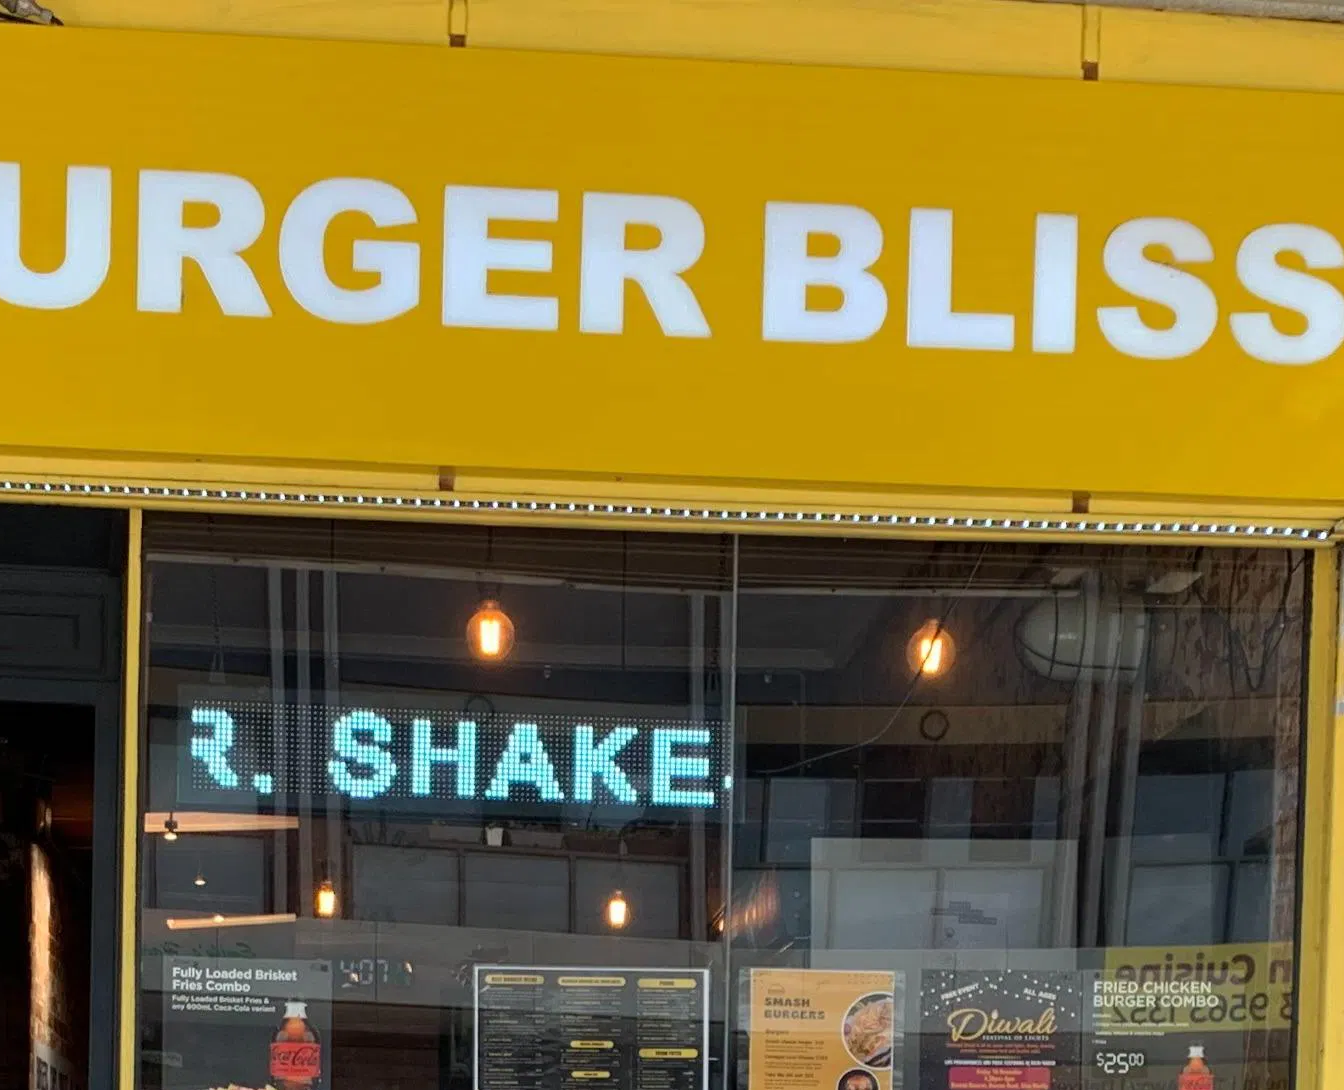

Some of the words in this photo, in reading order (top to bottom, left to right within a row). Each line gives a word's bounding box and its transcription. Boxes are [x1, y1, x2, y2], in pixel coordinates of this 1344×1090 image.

[328, 711, 733, 808] SHAKE
[172, 967, 203, 980] Fully
[206, 967, 253, 980] Loaded
[256, 968, 298, 981] Brisket
[172, 980, 203, 991] Fries
[205, 980, 250, 992] Combo
[1023, 987, 1037, 996] ALL
[1093, 981, 1138, 994] FRIED
[1143, 981, 1212, 994] CHICKEN
[172, 994, 191, 1003] Fully
[192, 994, 217, 1003] Loaded
[218, 995, 243, 1004] Brisket
[244, 996, 263, 1004] Fries
[764, 997, 810, 1008] SMASH
[1093, 995, 1156, 1008] BURGER
[1160, 995, 1219, 1008] COMBO
[213, 1004, 248, 1013] Coca-Cola
[764, 1010, 825, 1020] BURGERS
[947, 1008, 1057, 1041] Diwali
